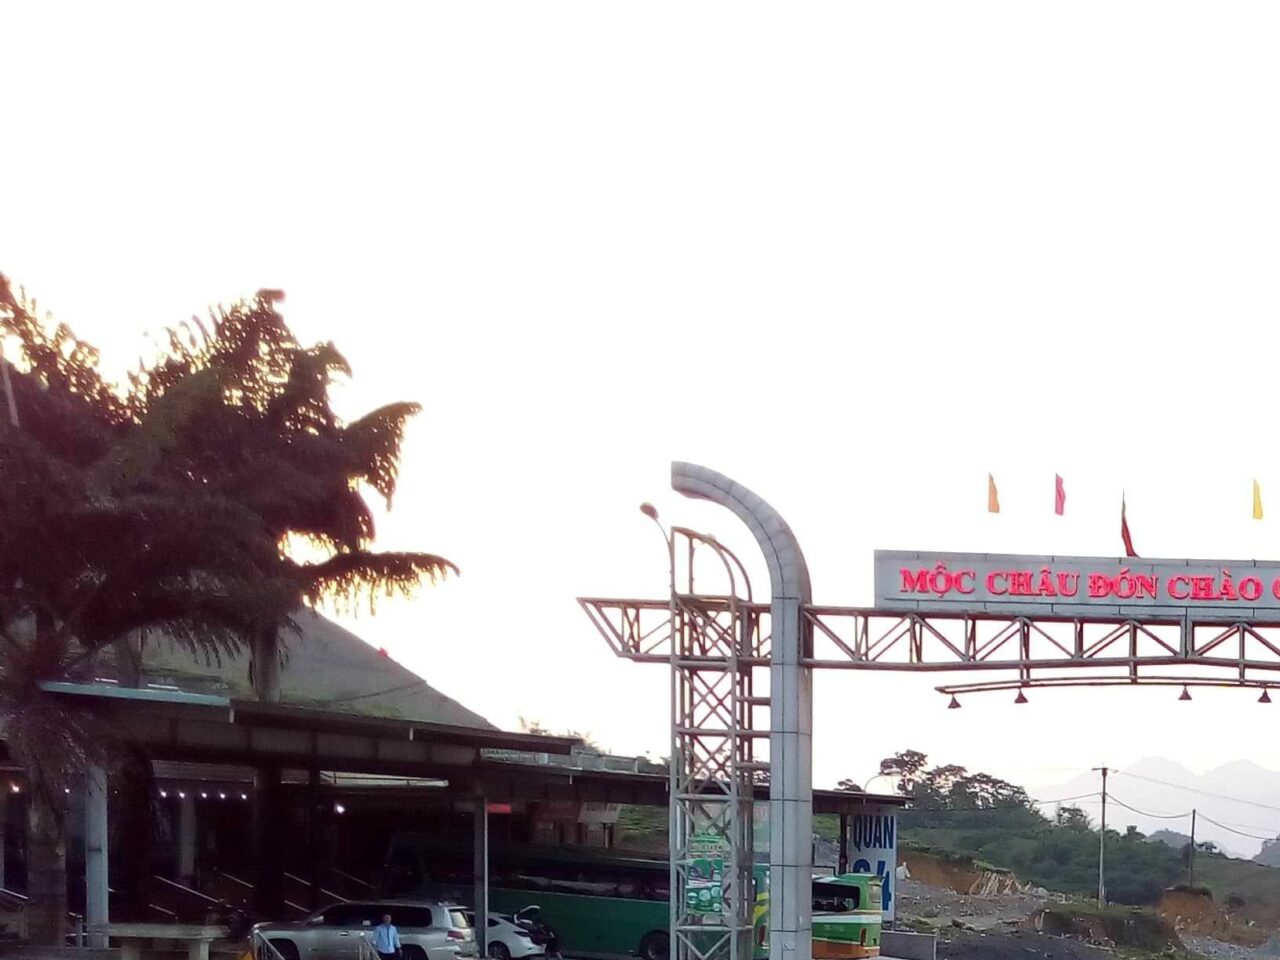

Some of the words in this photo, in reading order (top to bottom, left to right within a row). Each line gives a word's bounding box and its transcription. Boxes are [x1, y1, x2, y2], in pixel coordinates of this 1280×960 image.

[899, 563, 975, 598] MỘC
[985, 567, 1079, 598] CHÂU
[1088, 568, 1158, 600] ĐÓN
[1167, 572, 1264, 602] CHÀO
